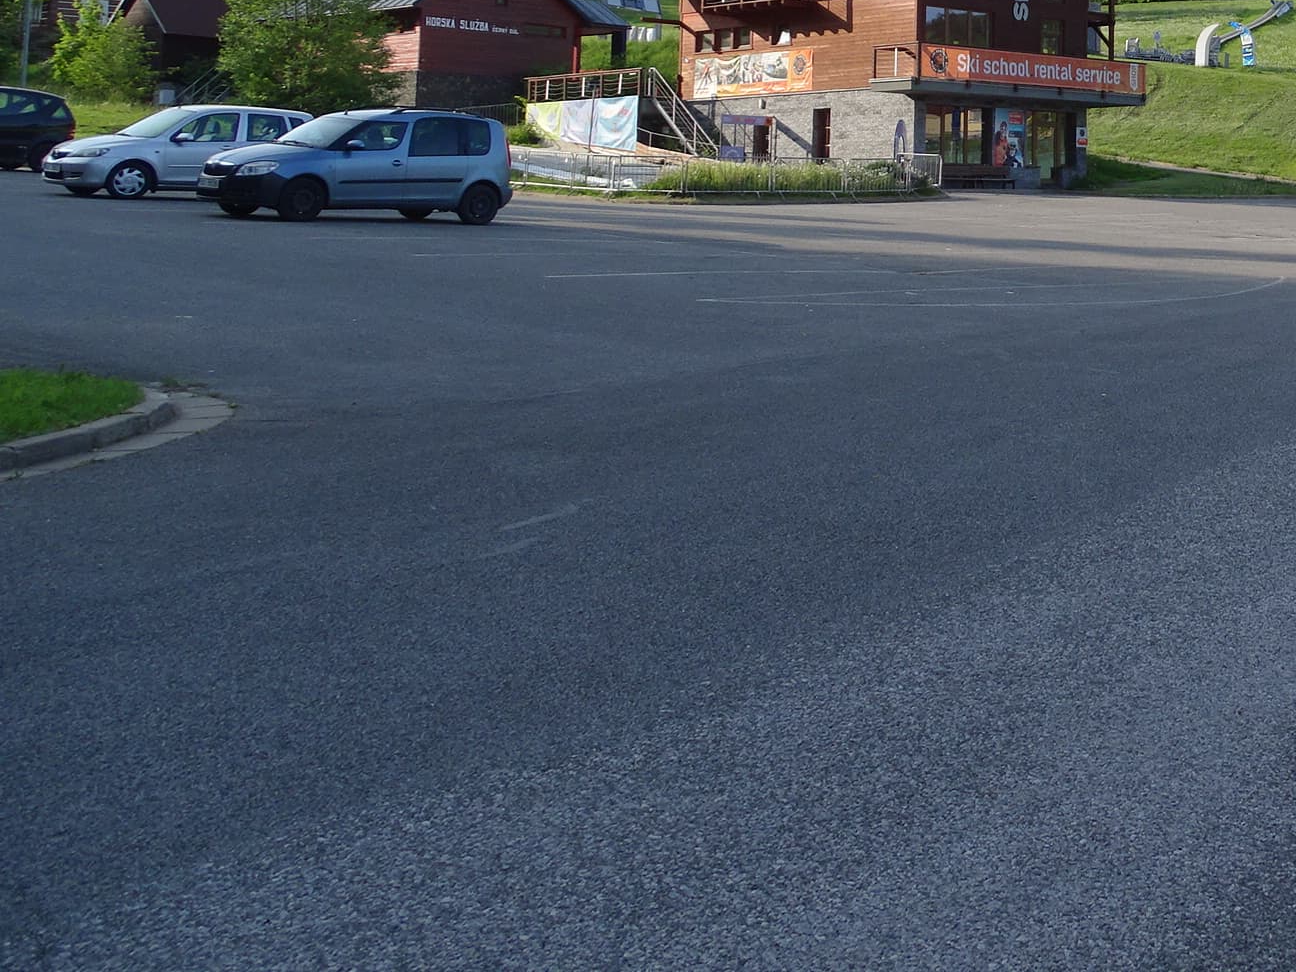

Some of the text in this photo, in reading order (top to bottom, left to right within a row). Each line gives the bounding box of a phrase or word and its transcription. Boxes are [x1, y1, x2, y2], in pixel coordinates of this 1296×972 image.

[459, 19, 489, 32] SLUŽBA
[956, 53, 980, 74] Ski
[982, 57, 1030, 78] school
[1034, 62, 1073, 81] rental
[1075, 66, 1121, 85] service
